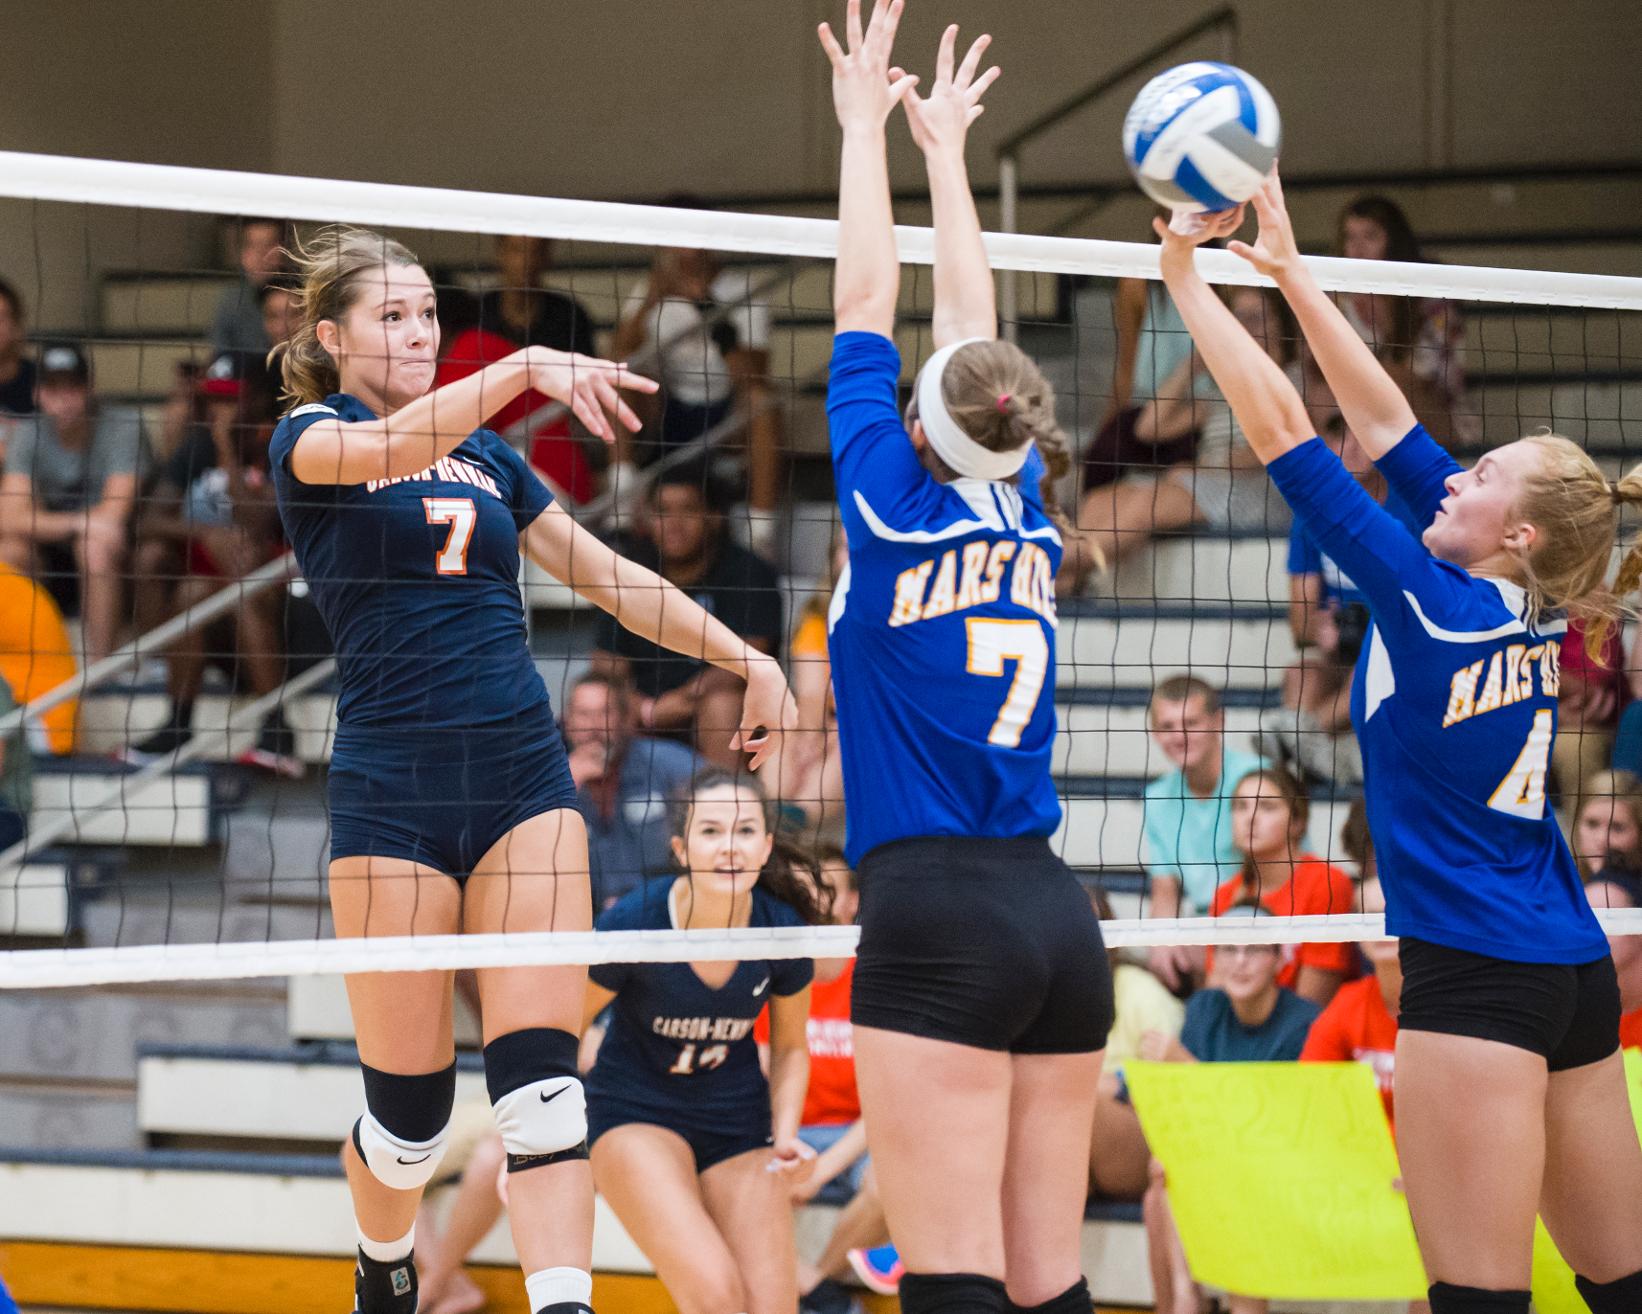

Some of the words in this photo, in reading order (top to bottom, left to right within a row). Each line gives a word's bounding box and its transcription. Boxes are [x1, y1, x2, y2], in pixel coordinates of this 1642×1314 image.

[421, 497, 477, 575] 7
[887, 540, 1016, 627] MARS
[965, 617, 1049, 748] 7
[1442, 644, 1546, 728] MARS
[1486, 708, 1553, 820] 4
